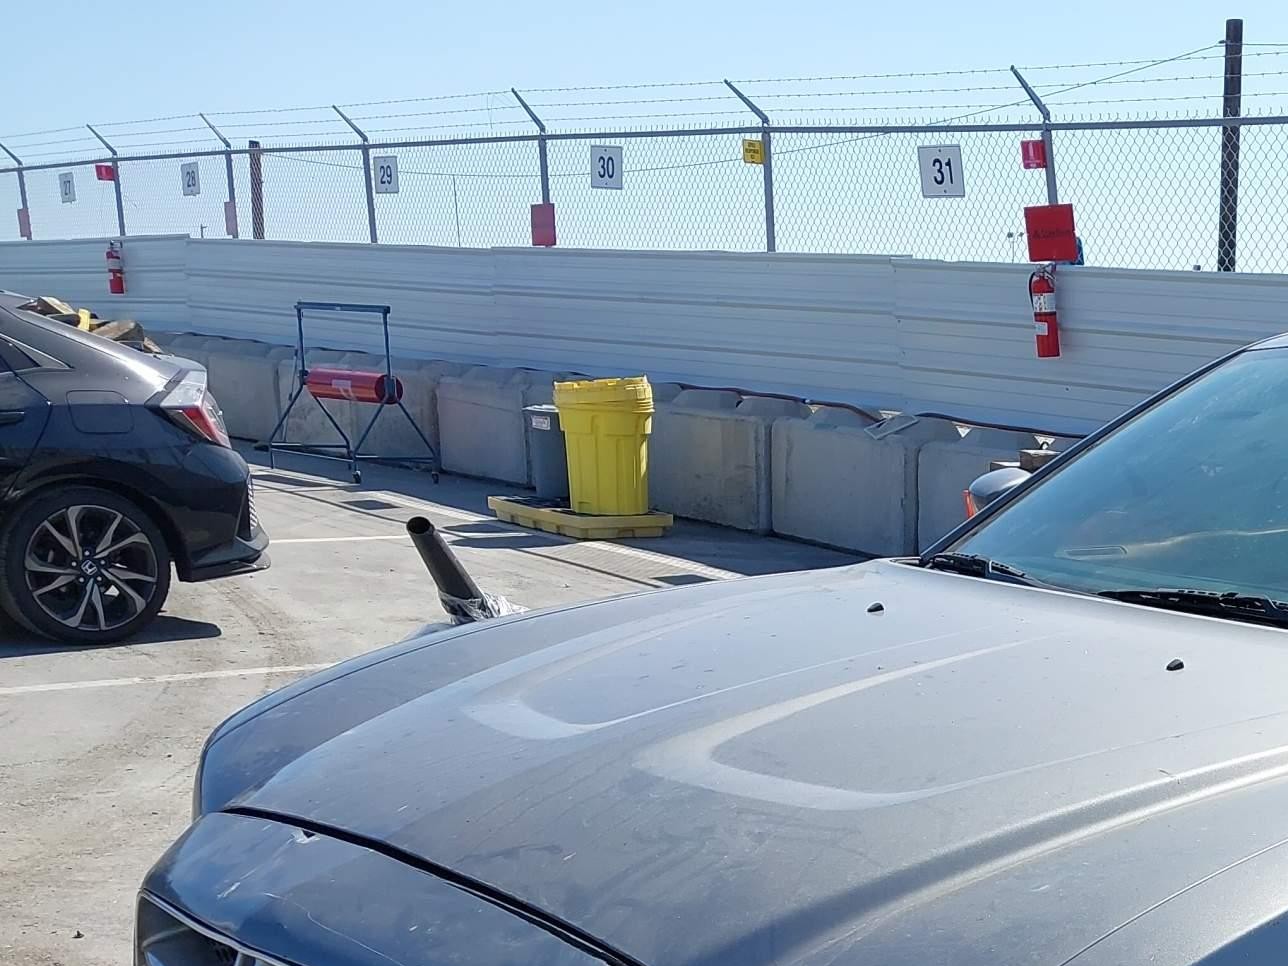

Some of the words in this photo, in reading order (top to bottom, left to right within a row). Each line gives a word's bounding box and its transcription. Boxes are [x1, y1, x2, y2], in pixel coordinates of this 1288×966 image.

[186, 170, 196, 187] 28
[379, 164, 393, 185] 29
[598, 156, 615, 179] 30
[932, 157, 954, 185] 31
